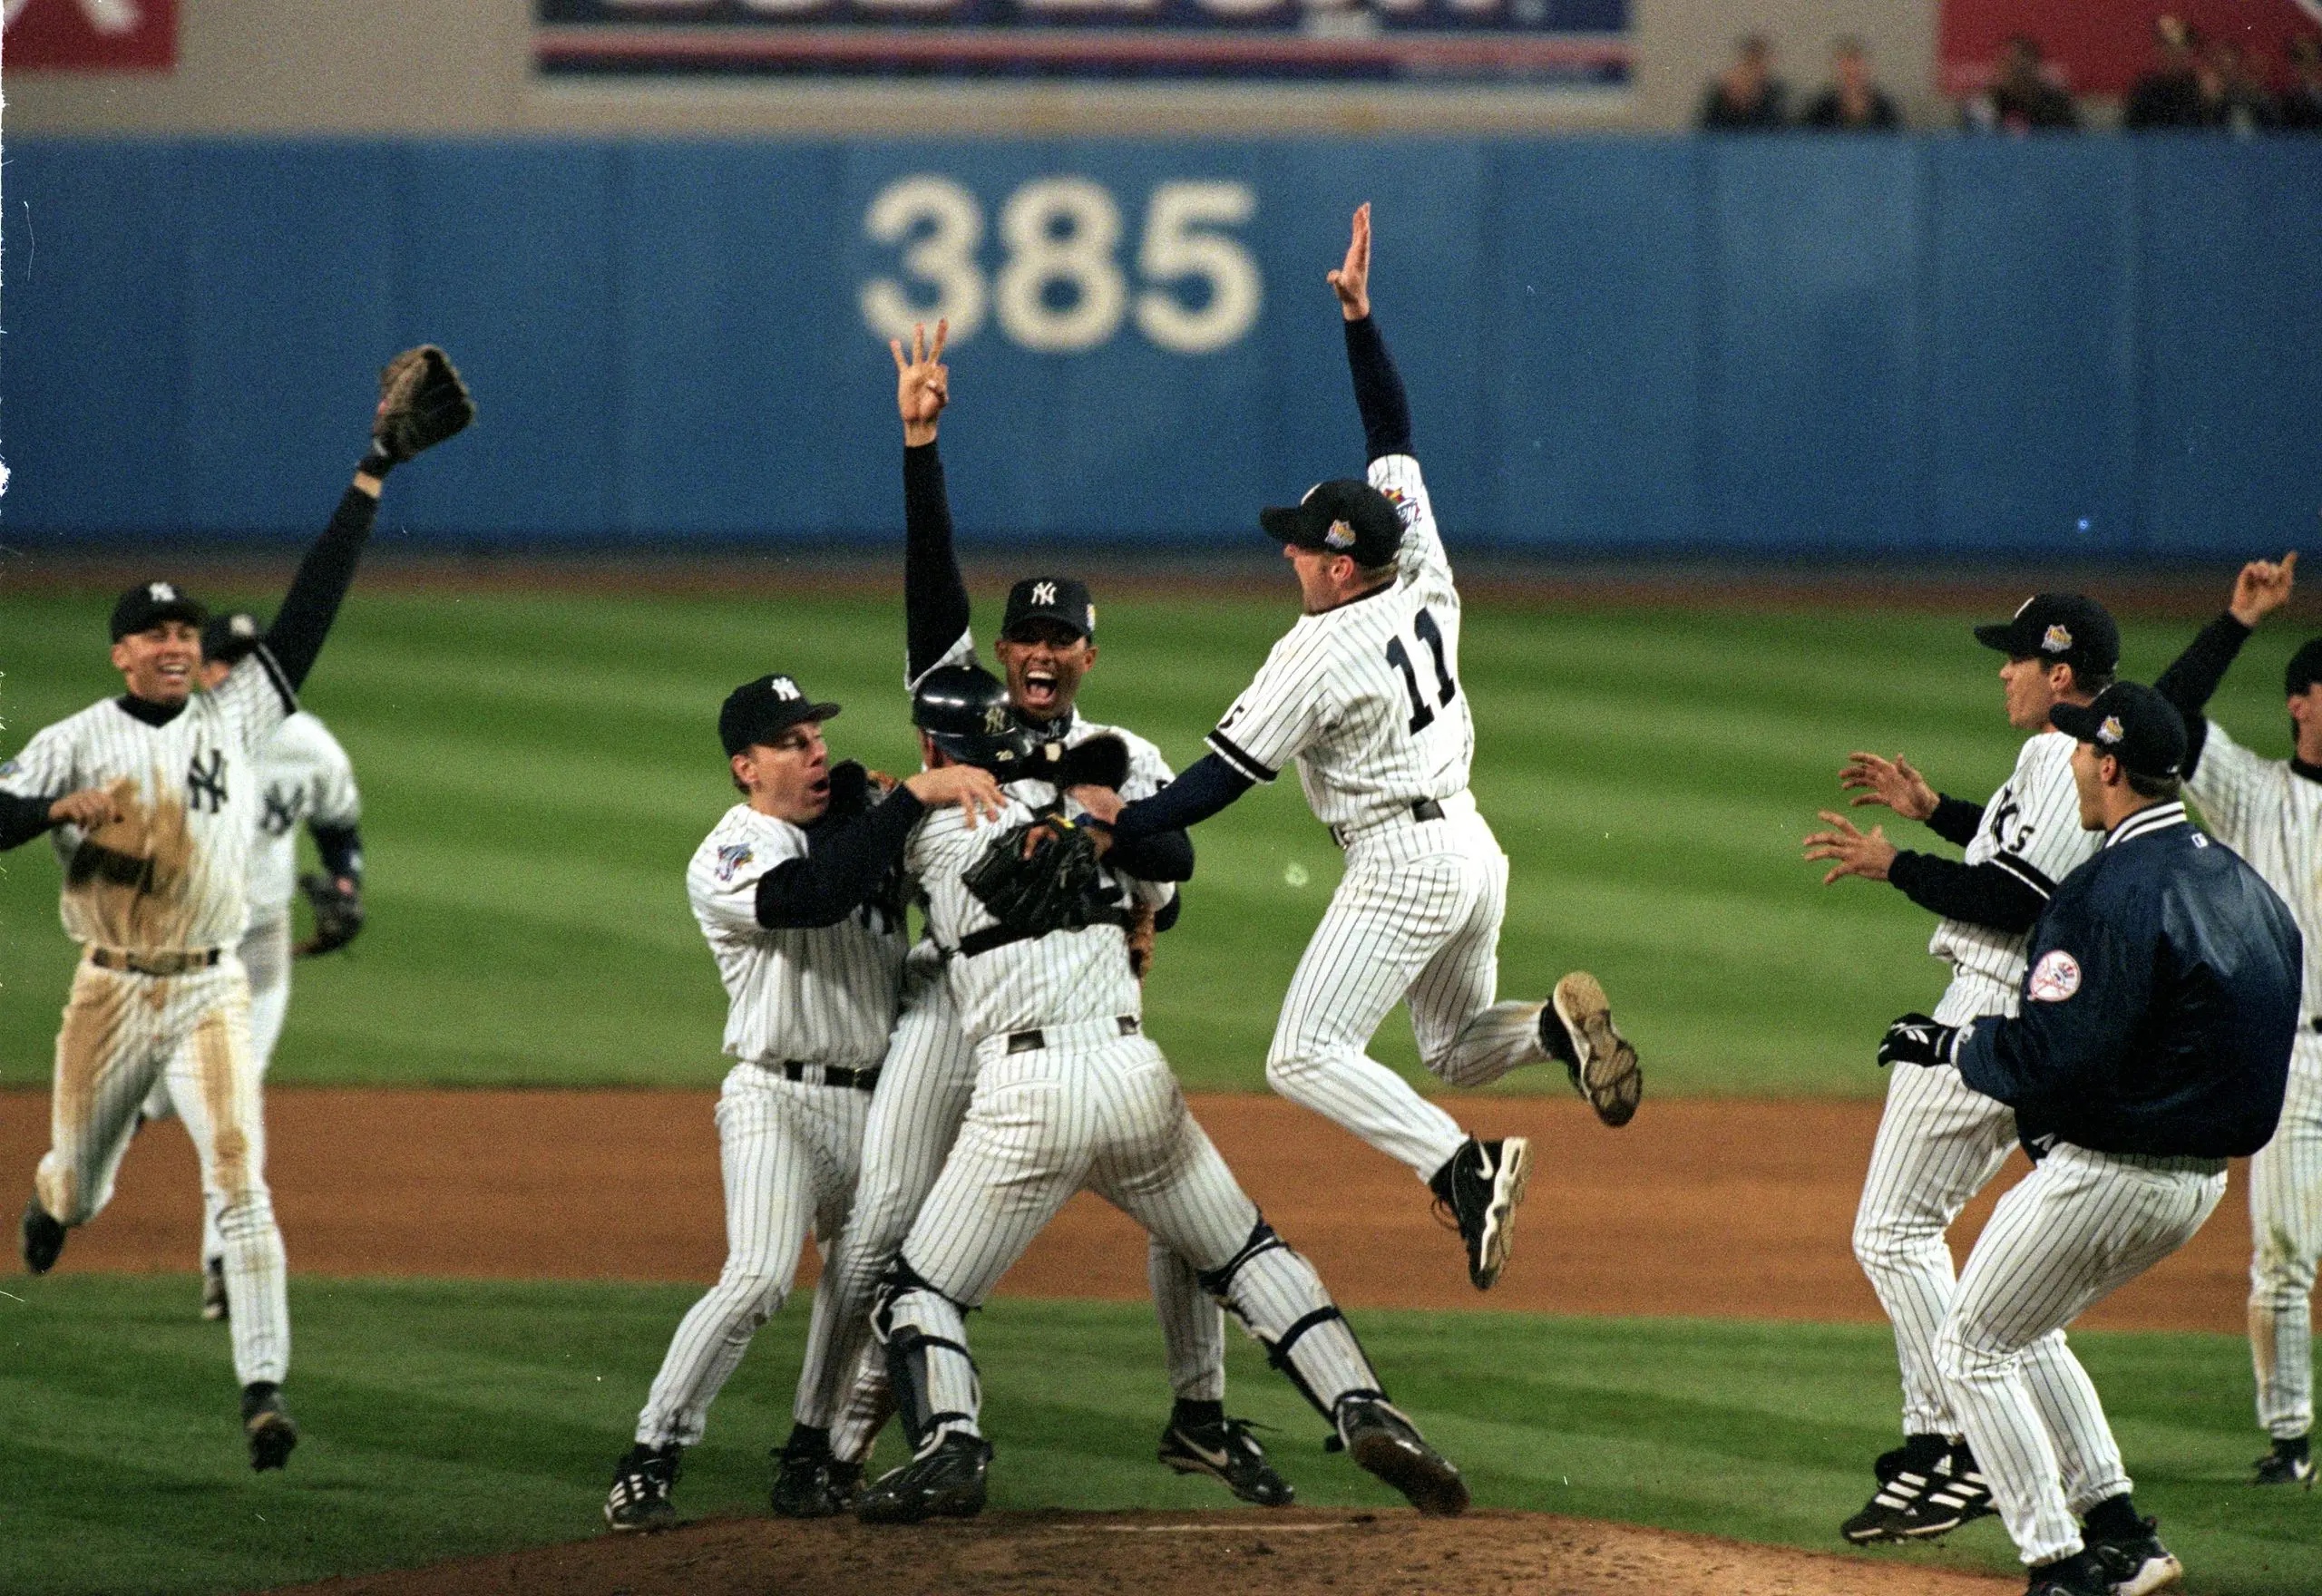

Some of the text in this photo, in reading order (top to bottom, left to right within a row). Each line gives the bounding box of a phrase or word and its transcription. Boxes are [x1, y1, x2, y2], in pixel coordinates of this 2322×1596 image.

[863, 175, 1262, 352] 385
[1031, 582, 1057, 606] NY
[1386, 606, 1456, 736] 11
[188, 749, 229, 813] NY
[2008, 825, 2035, 852] 5
